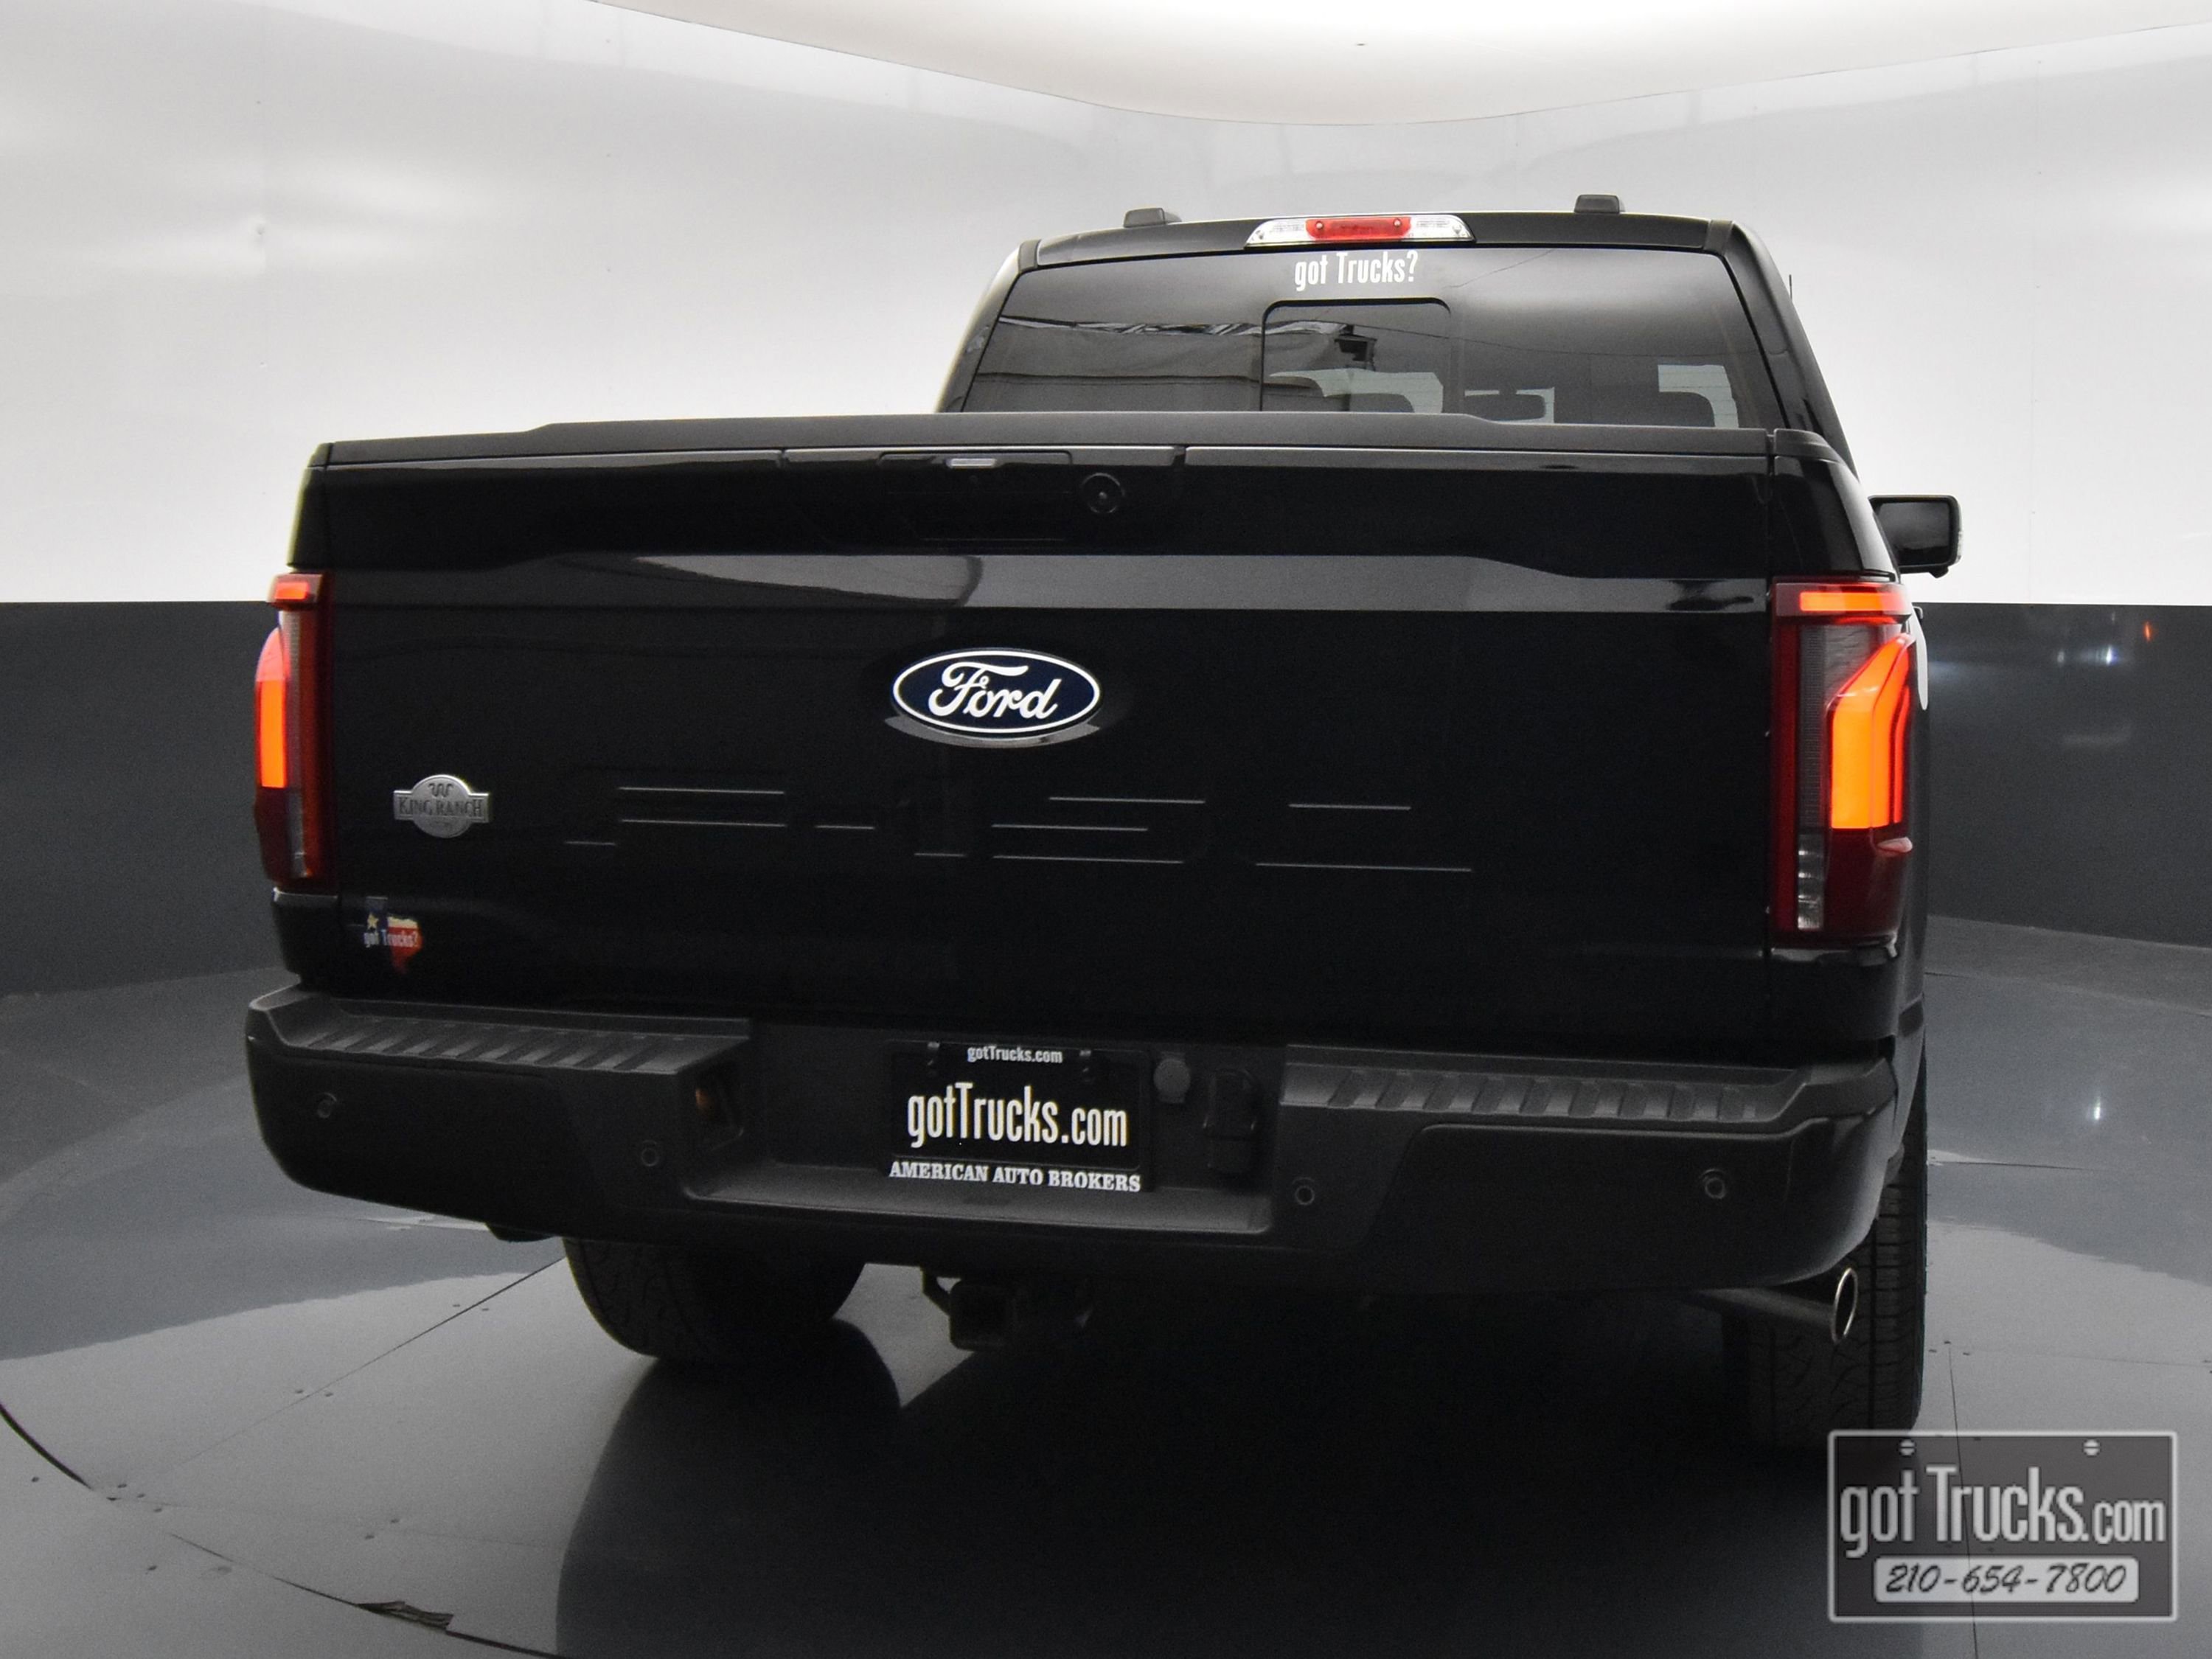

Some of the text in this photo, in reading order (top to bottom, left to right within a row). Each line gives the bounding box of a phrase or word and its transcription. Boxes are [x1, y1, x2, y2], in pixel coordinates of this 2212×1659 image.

[1294, 250, 1419, 291] got Trucks?
[928, 662, 1062, 720] Ford
[398, 796, 483, 818] KING RANCH
[967, 1045, 1063, 1063] gotTrucks.com
[907, 1082, 1127, 1148] gotTrucks.com
[888, 1161, 1141, 1192] AMERICAN AUTO BROKERS
